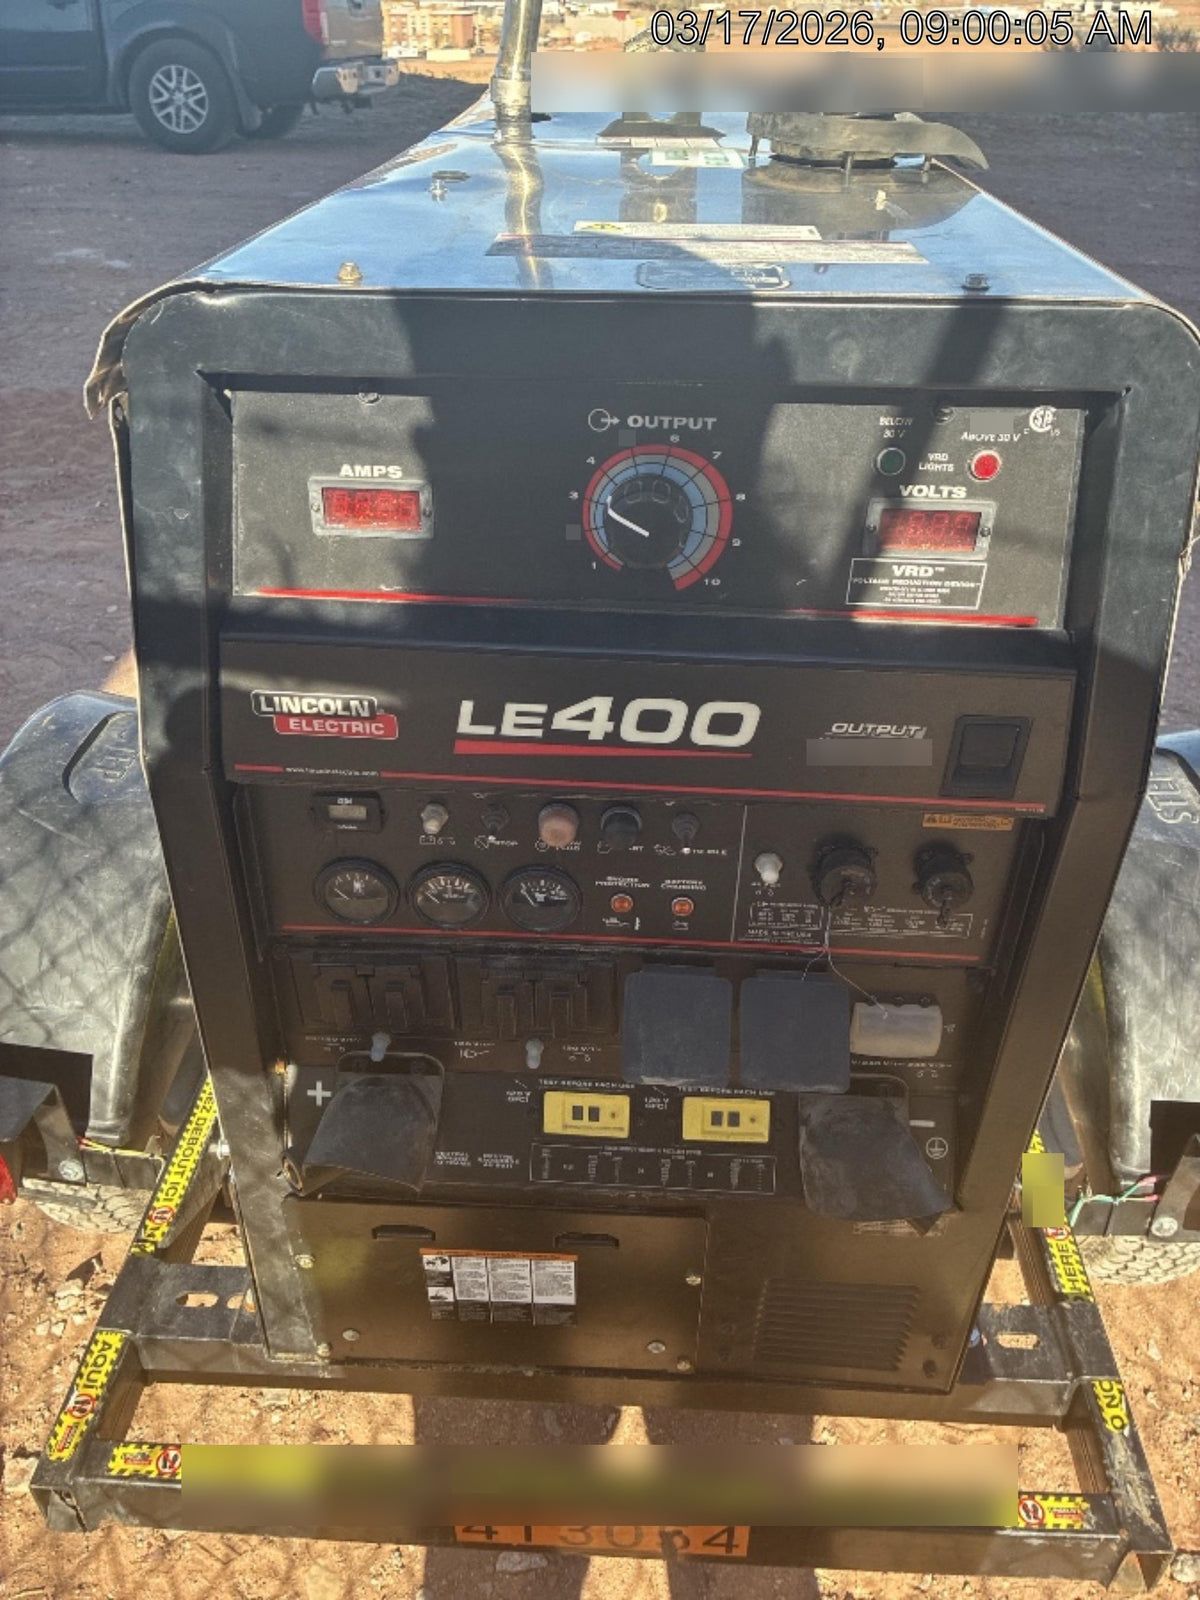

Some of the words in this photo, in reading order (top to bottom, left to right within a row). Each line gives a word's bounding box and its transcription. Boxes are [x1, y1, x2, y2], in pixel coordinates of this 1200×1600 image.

[627, 415, 717, 430] OUTPUT
[669, 434, 680, 443] 6
[586, 456, 596, 465] 4
[712, 451, 722, 460] 7
[928, 453, 949, 462] VRD
[339, 463, 403, 479] AMPS
[918, 462, 954, 473] LIGHTS
[899, 484, 968, 499] VOLTS
[731, 538, 742, 548] 9
[591, 562, 597, 570] 1
[704, 578, 721, 586] 10
[259, 695, 370, 718] LINCOLN
[288, 717, 385, 736] ELECTRIC
[456, 696, 762, 748] LE400
[831, 722, 921, 737] OUTPUT
[176, 1117, 207, 1176] DEBOUT
[163, 1181, 179, 1202] ICI
[1057, 1242, 1081, 1291] HERE
